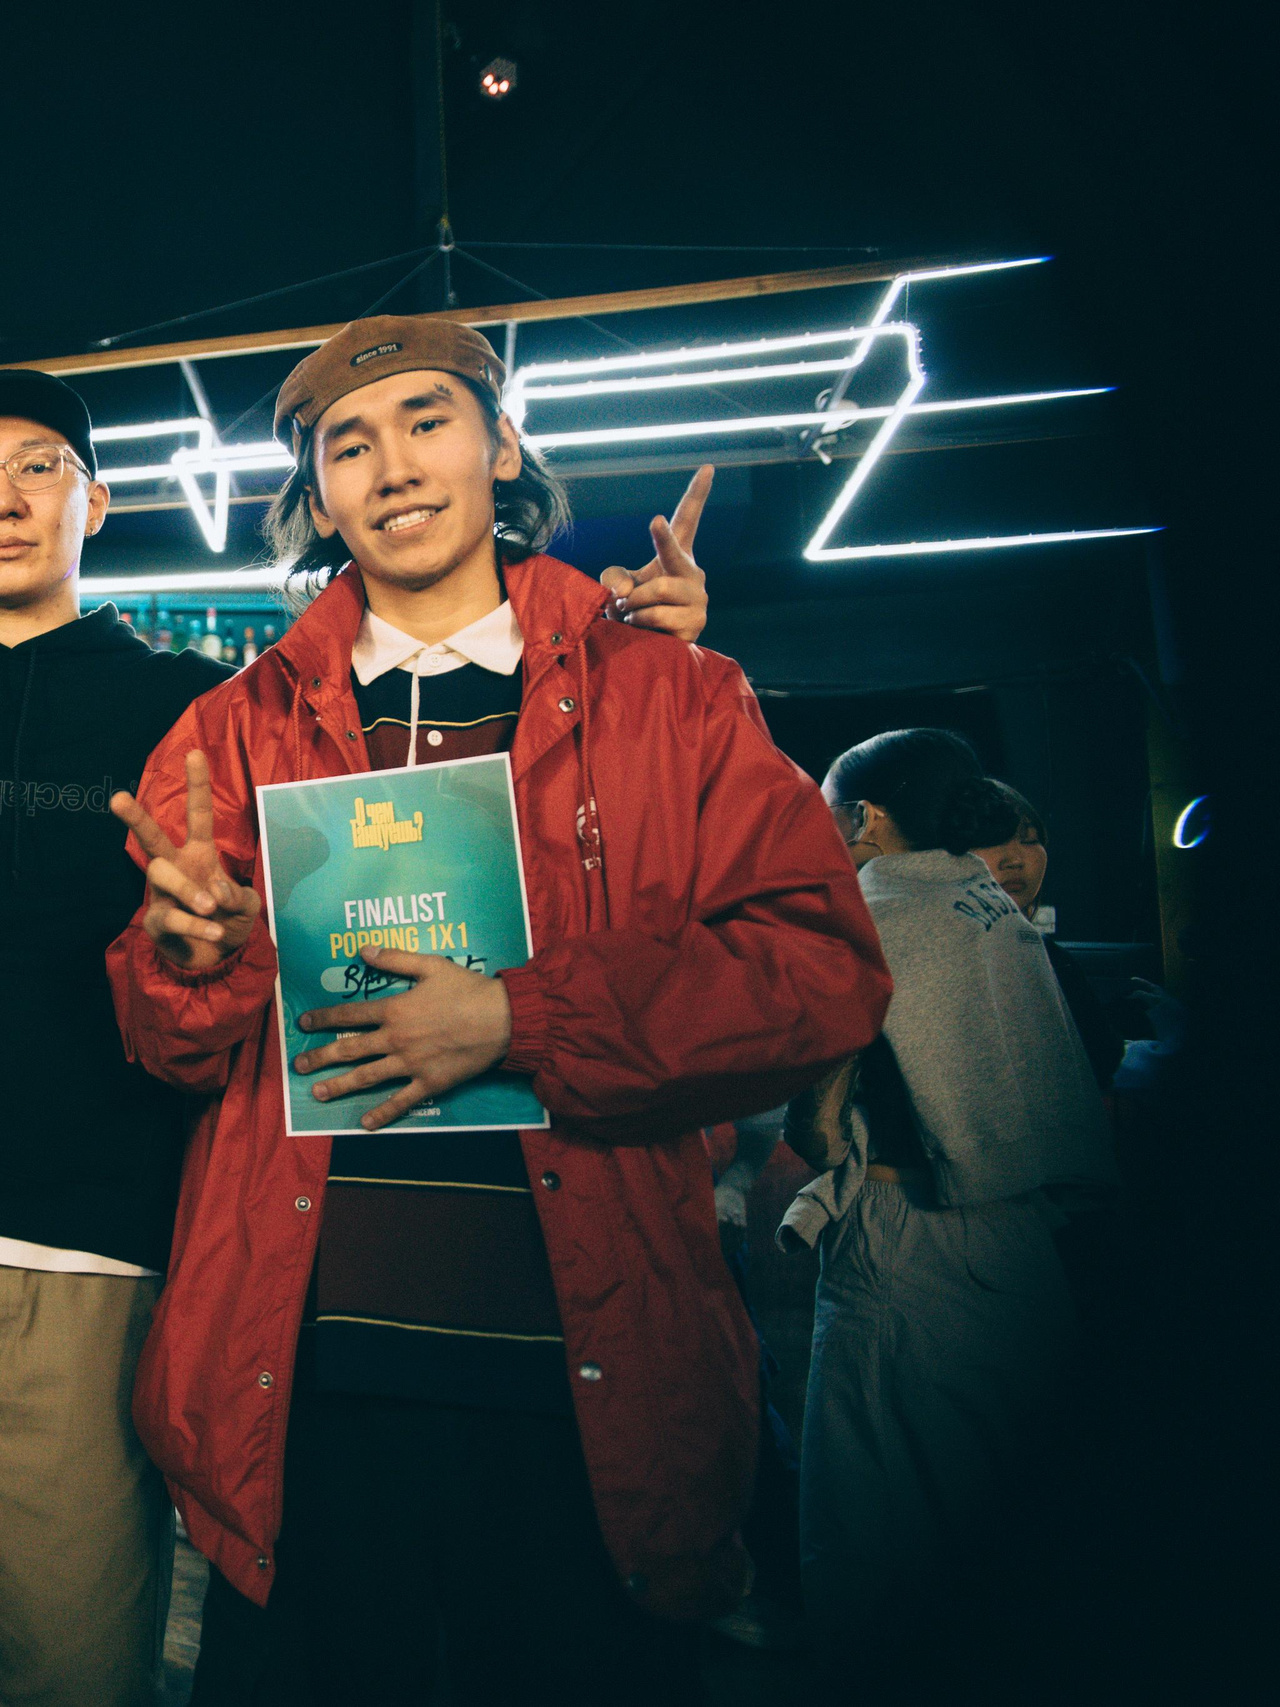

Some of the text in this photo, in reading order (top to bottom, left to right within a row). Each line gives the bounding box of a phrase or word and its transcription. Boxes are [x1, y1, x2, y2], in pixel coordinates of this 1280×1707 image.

[356, 343, 398, 364] since 1991
[344, 891, 448, 930] FINALIST
[329, 926, 419, 960] POPPING
